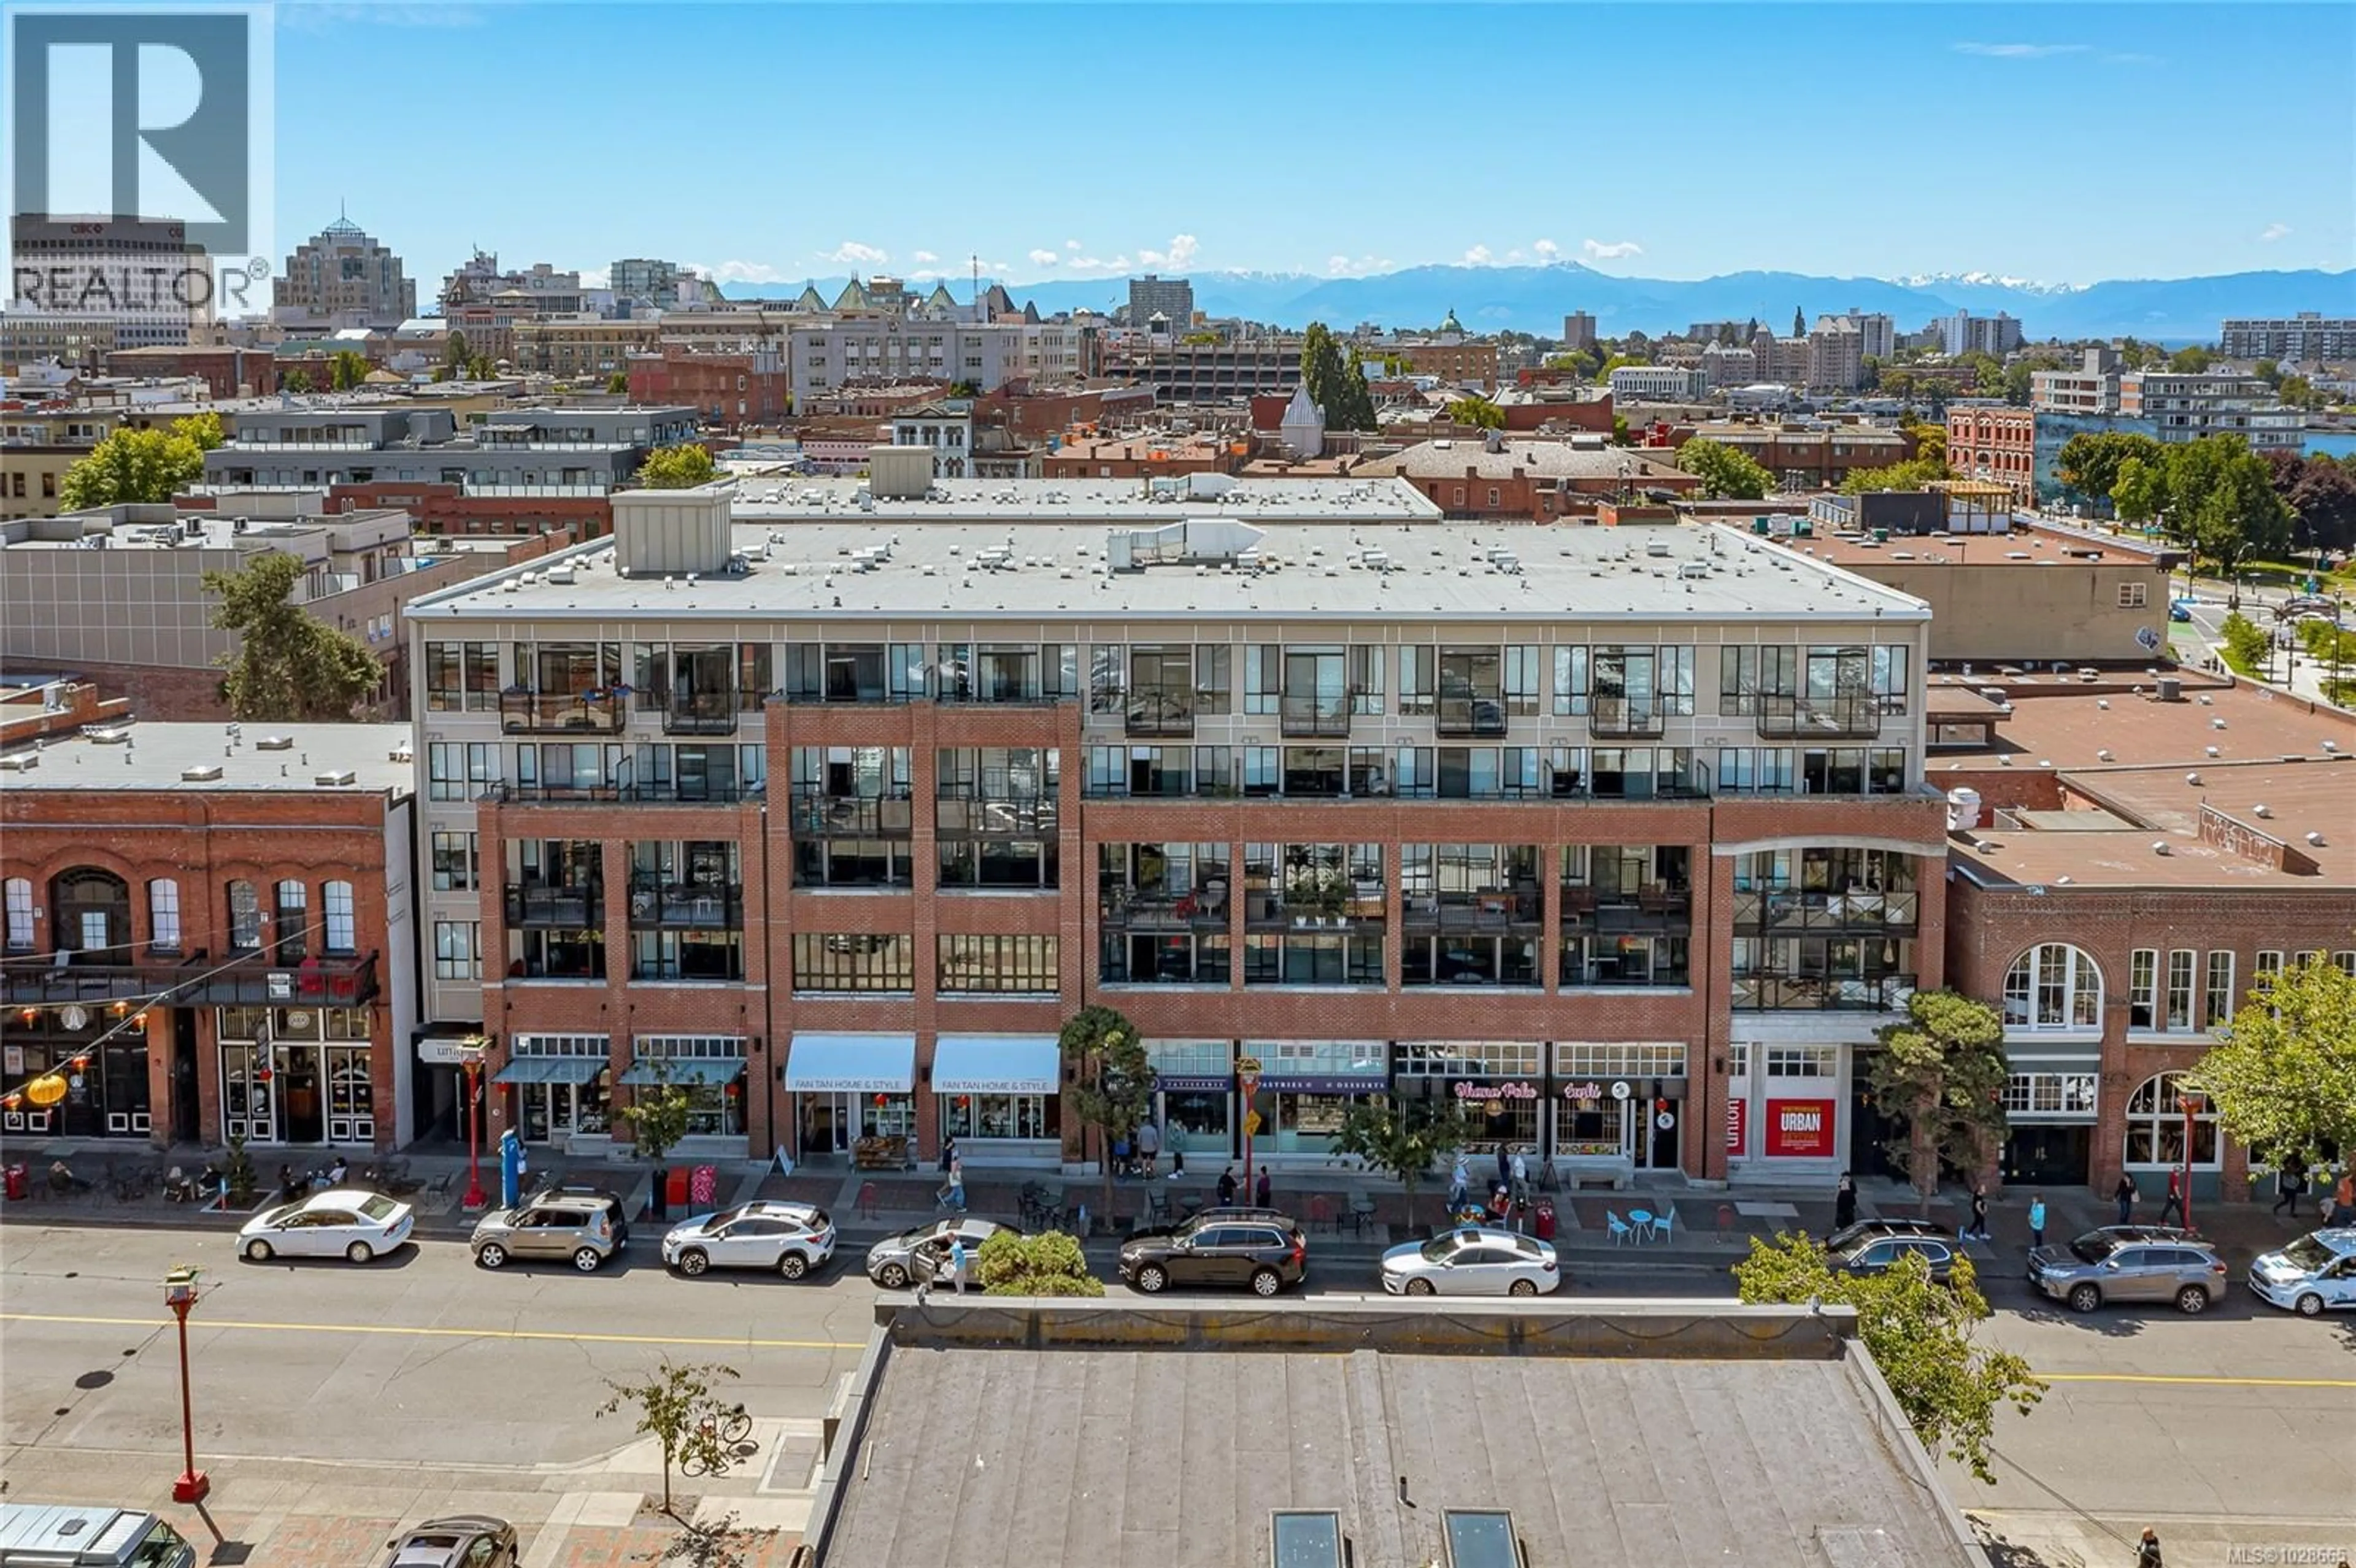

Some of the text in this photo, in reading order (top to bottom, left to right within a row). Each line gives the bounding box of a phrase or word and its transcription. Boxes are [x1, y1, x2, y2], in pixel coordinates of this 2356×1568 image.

[795, 1080, 900, 1089] FAN TAN HOME & STYLE
[942, 1082, 1047, 1091] FAN TAN HOME & STYLE
[1727, 1099, 1740, 1147] union
[1780, 1112, 1821, 1132] URBAN
